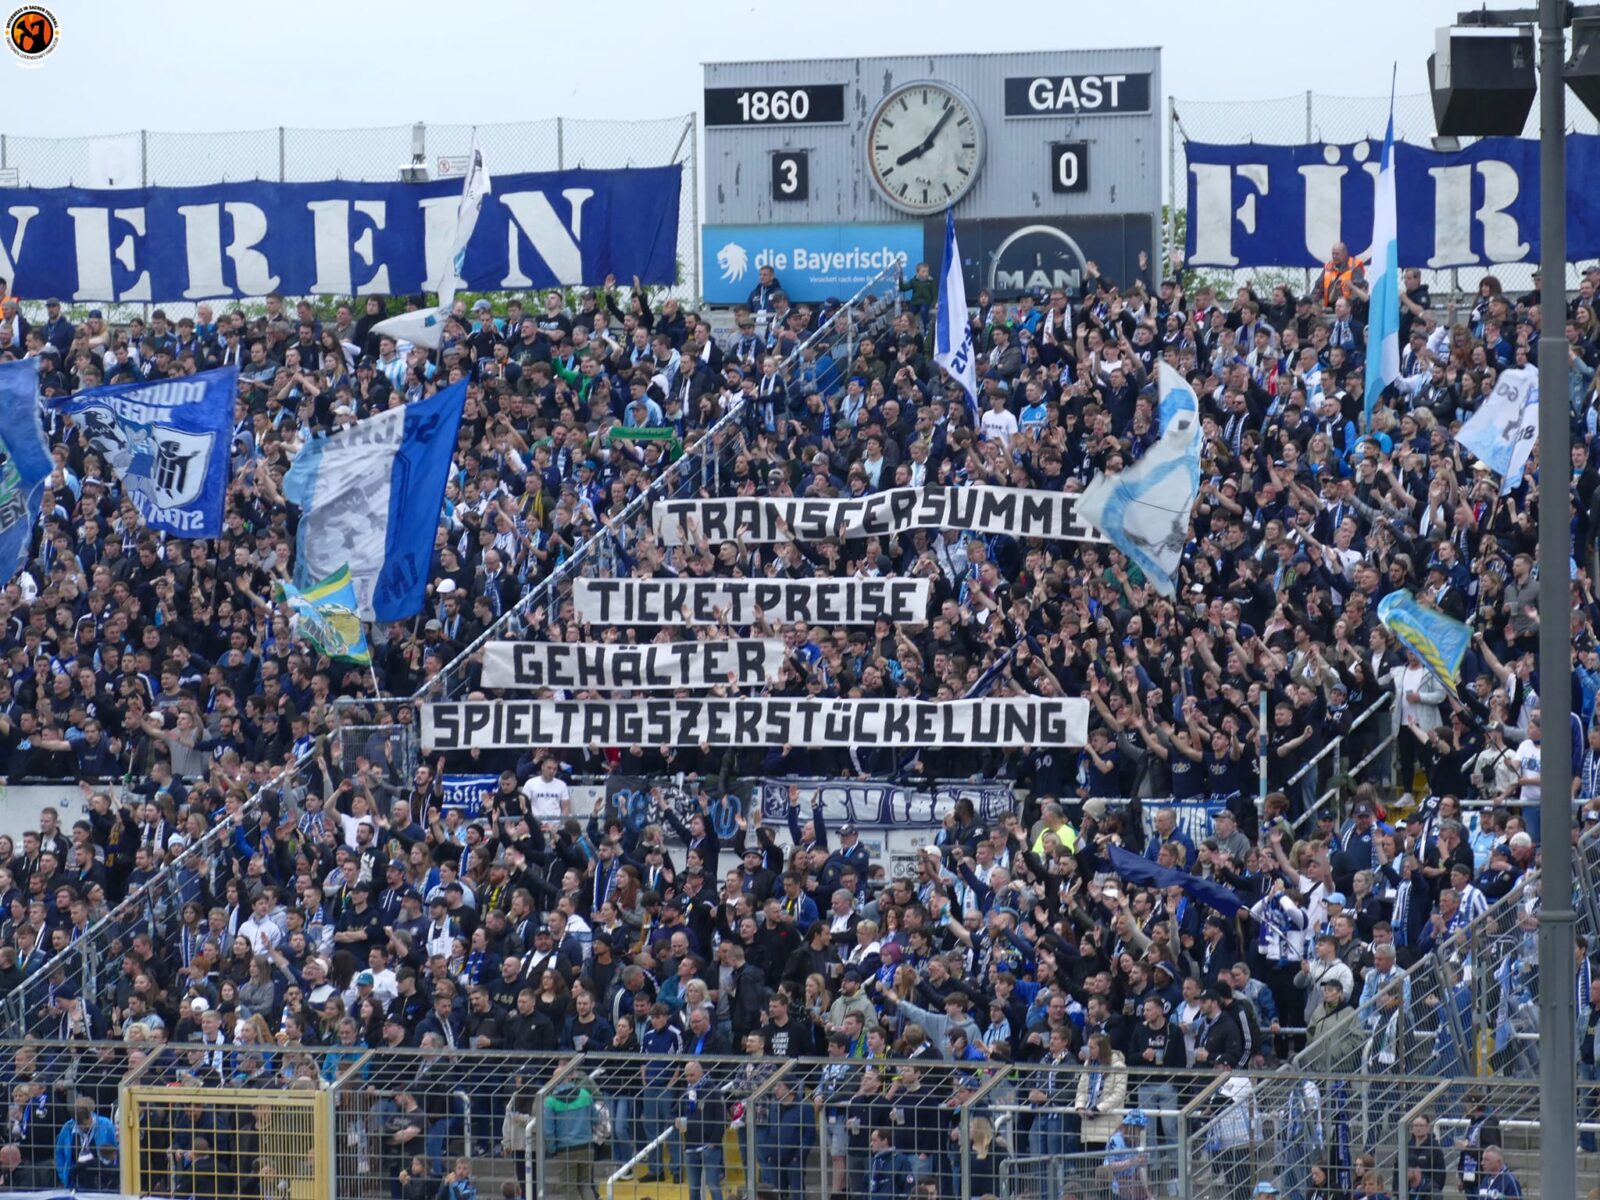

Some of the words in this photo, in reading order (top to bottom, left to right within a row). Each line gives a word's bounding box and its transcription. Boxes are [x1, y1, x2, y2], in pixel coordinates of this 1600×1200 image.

[737, 90, 810, 121] 1860
[1028, 75, 1126, 111] GAST
[780, 158, 798, 194] 3
[1059, 151, 1078, 187] 0
[1188, 141, 1530, 269] FÜR
[754, 249, 788, 270] die
[793, 246, 908, 273] Bayerische
[997, 269, 1080, 289] MAN
[667, 486, 1111, 542] TRANSFERSUMME
[588, 581, 917, 623] TICKETPREISE
[514, 641, 766, 687] GEHÄLTER
[433, 701, 1067, 748] SPIELTAGSZERSTÜCKELUNG
